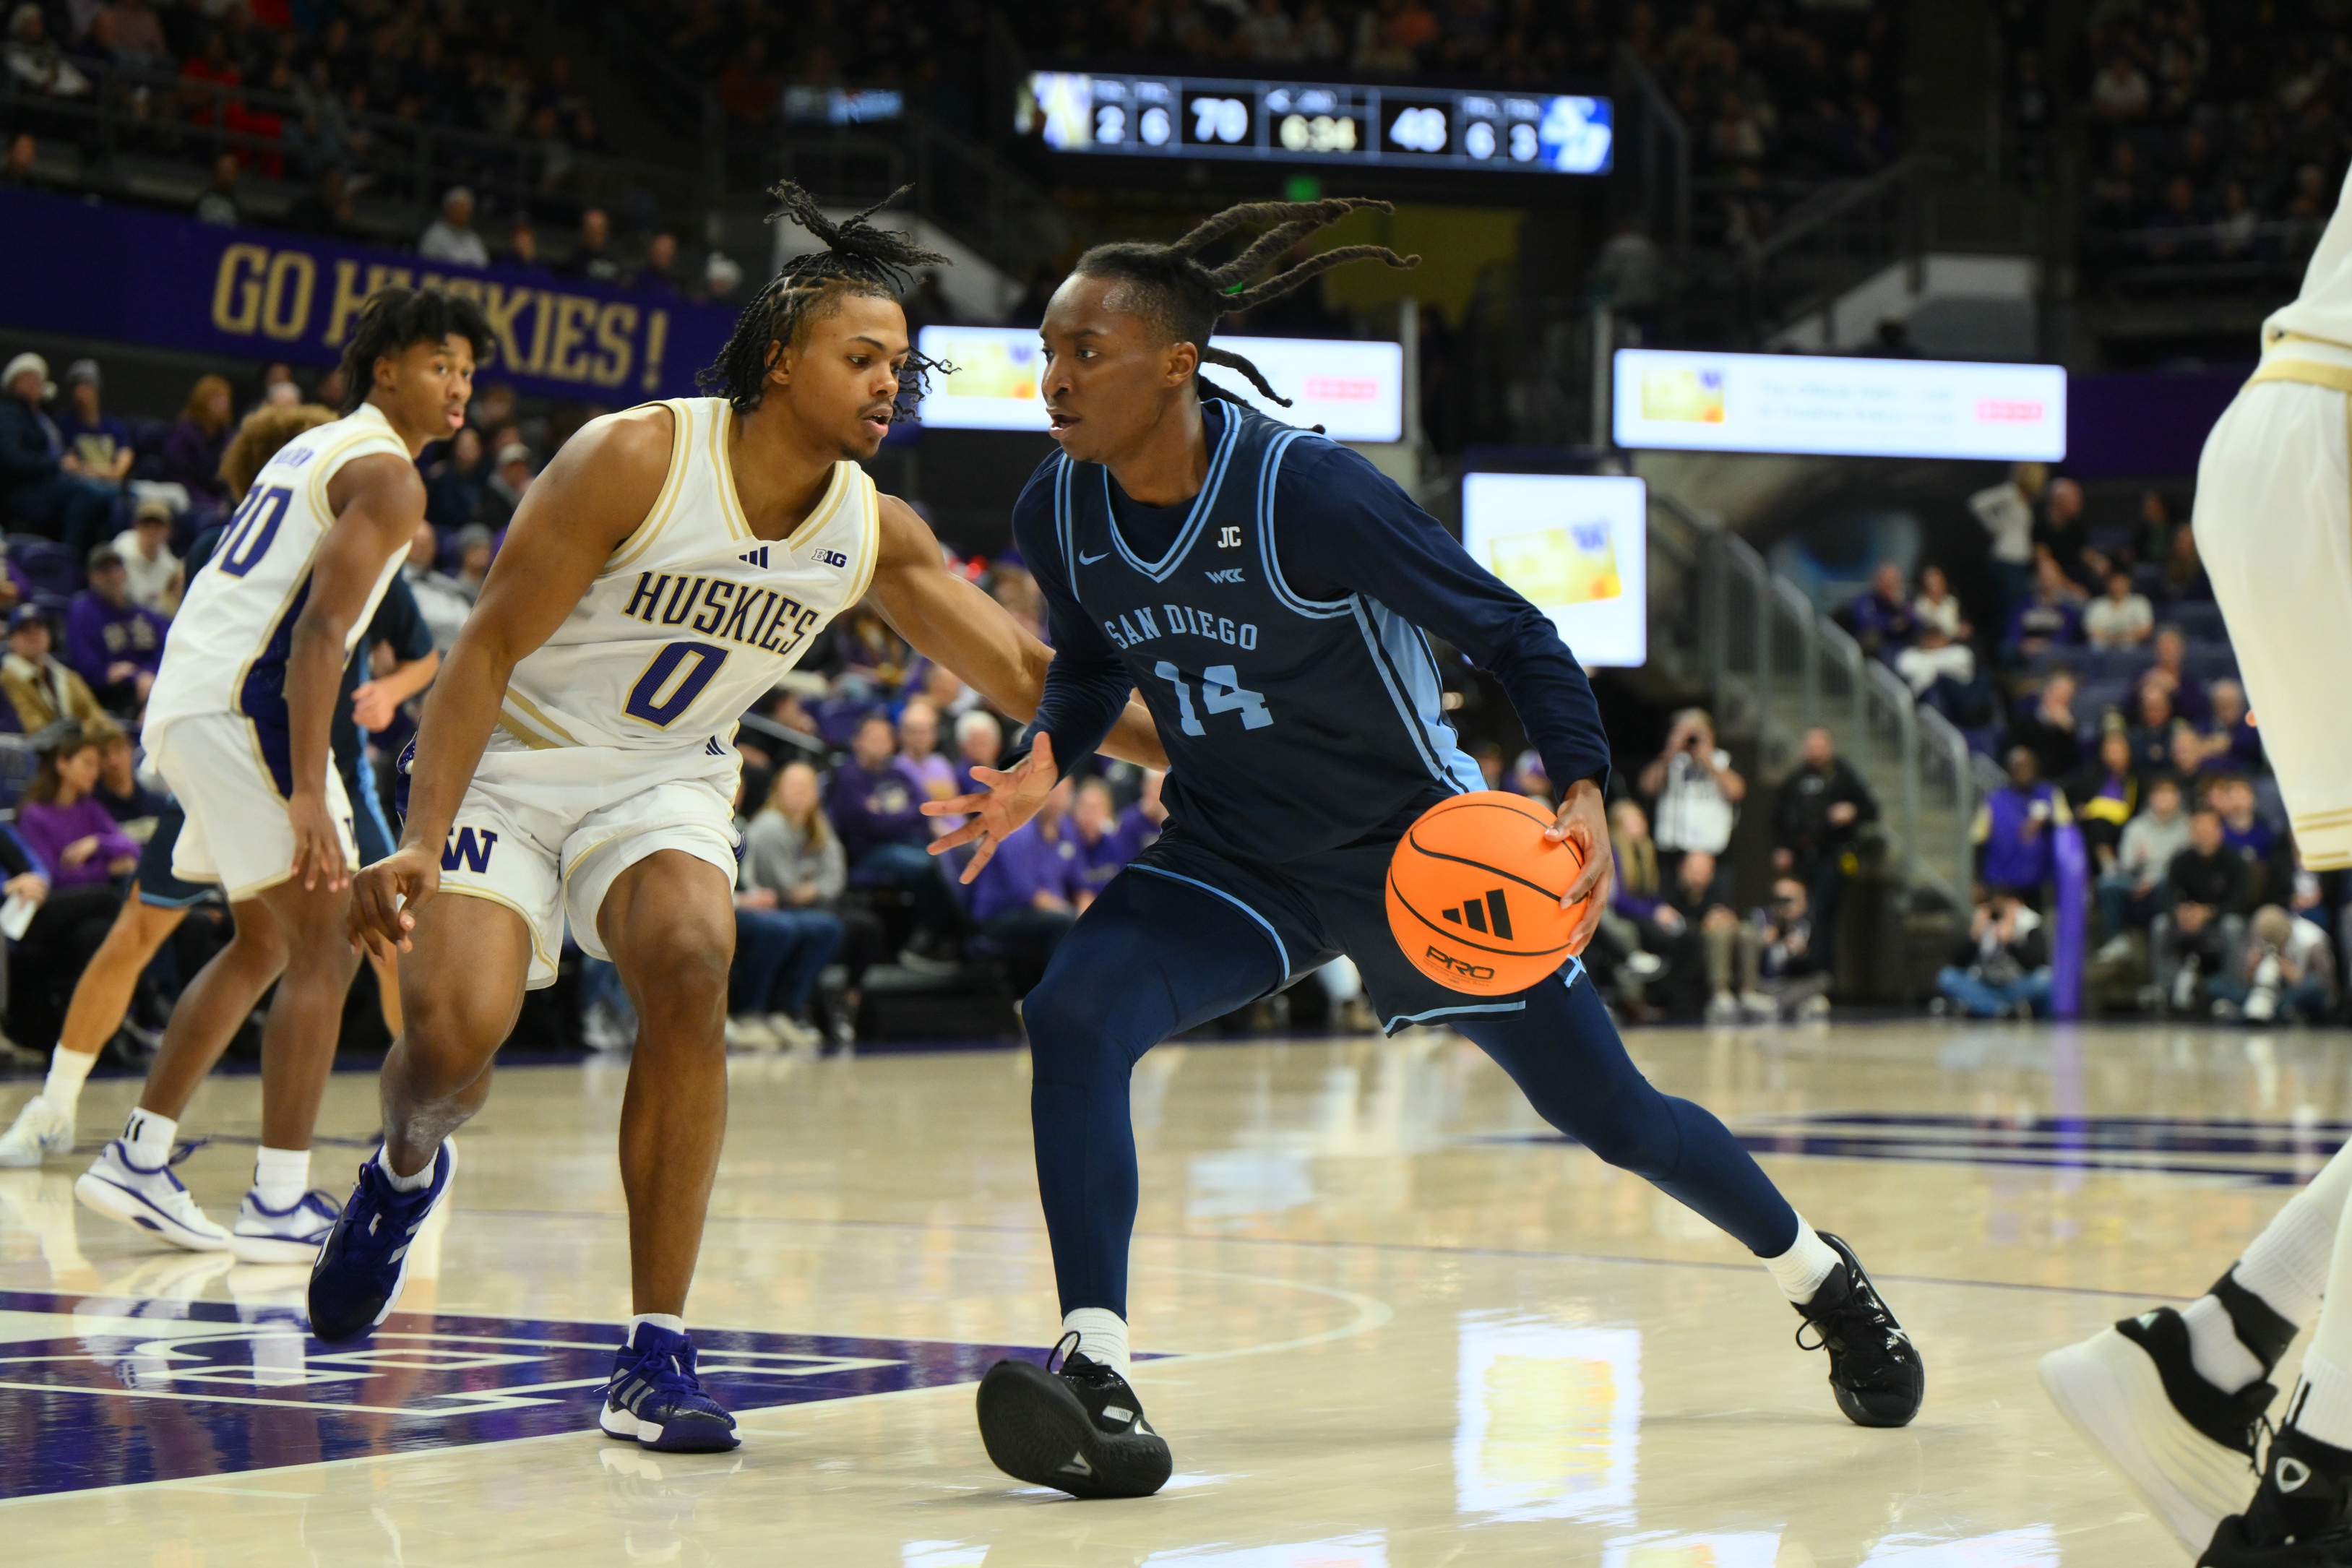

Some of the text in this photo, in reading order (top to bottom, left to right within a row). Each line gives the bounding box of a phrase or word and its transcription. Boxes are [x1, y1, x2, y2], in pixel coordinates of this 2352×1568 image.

[1191, 98, 1248, 143] 70
[211, 244, 669, 393] GO HKIES!
[1218, 526, 1241, 548] JC
[621, 571, 820, 657] HUSKIES
[1105, 604, 1257, 650] SAN DIEGO
[621, 641, 733, 731] 0
[1155, 660, 1274, 736] 14
[440, 826, 498, 874] W
[1426, 945, 1494, 979] PRO
